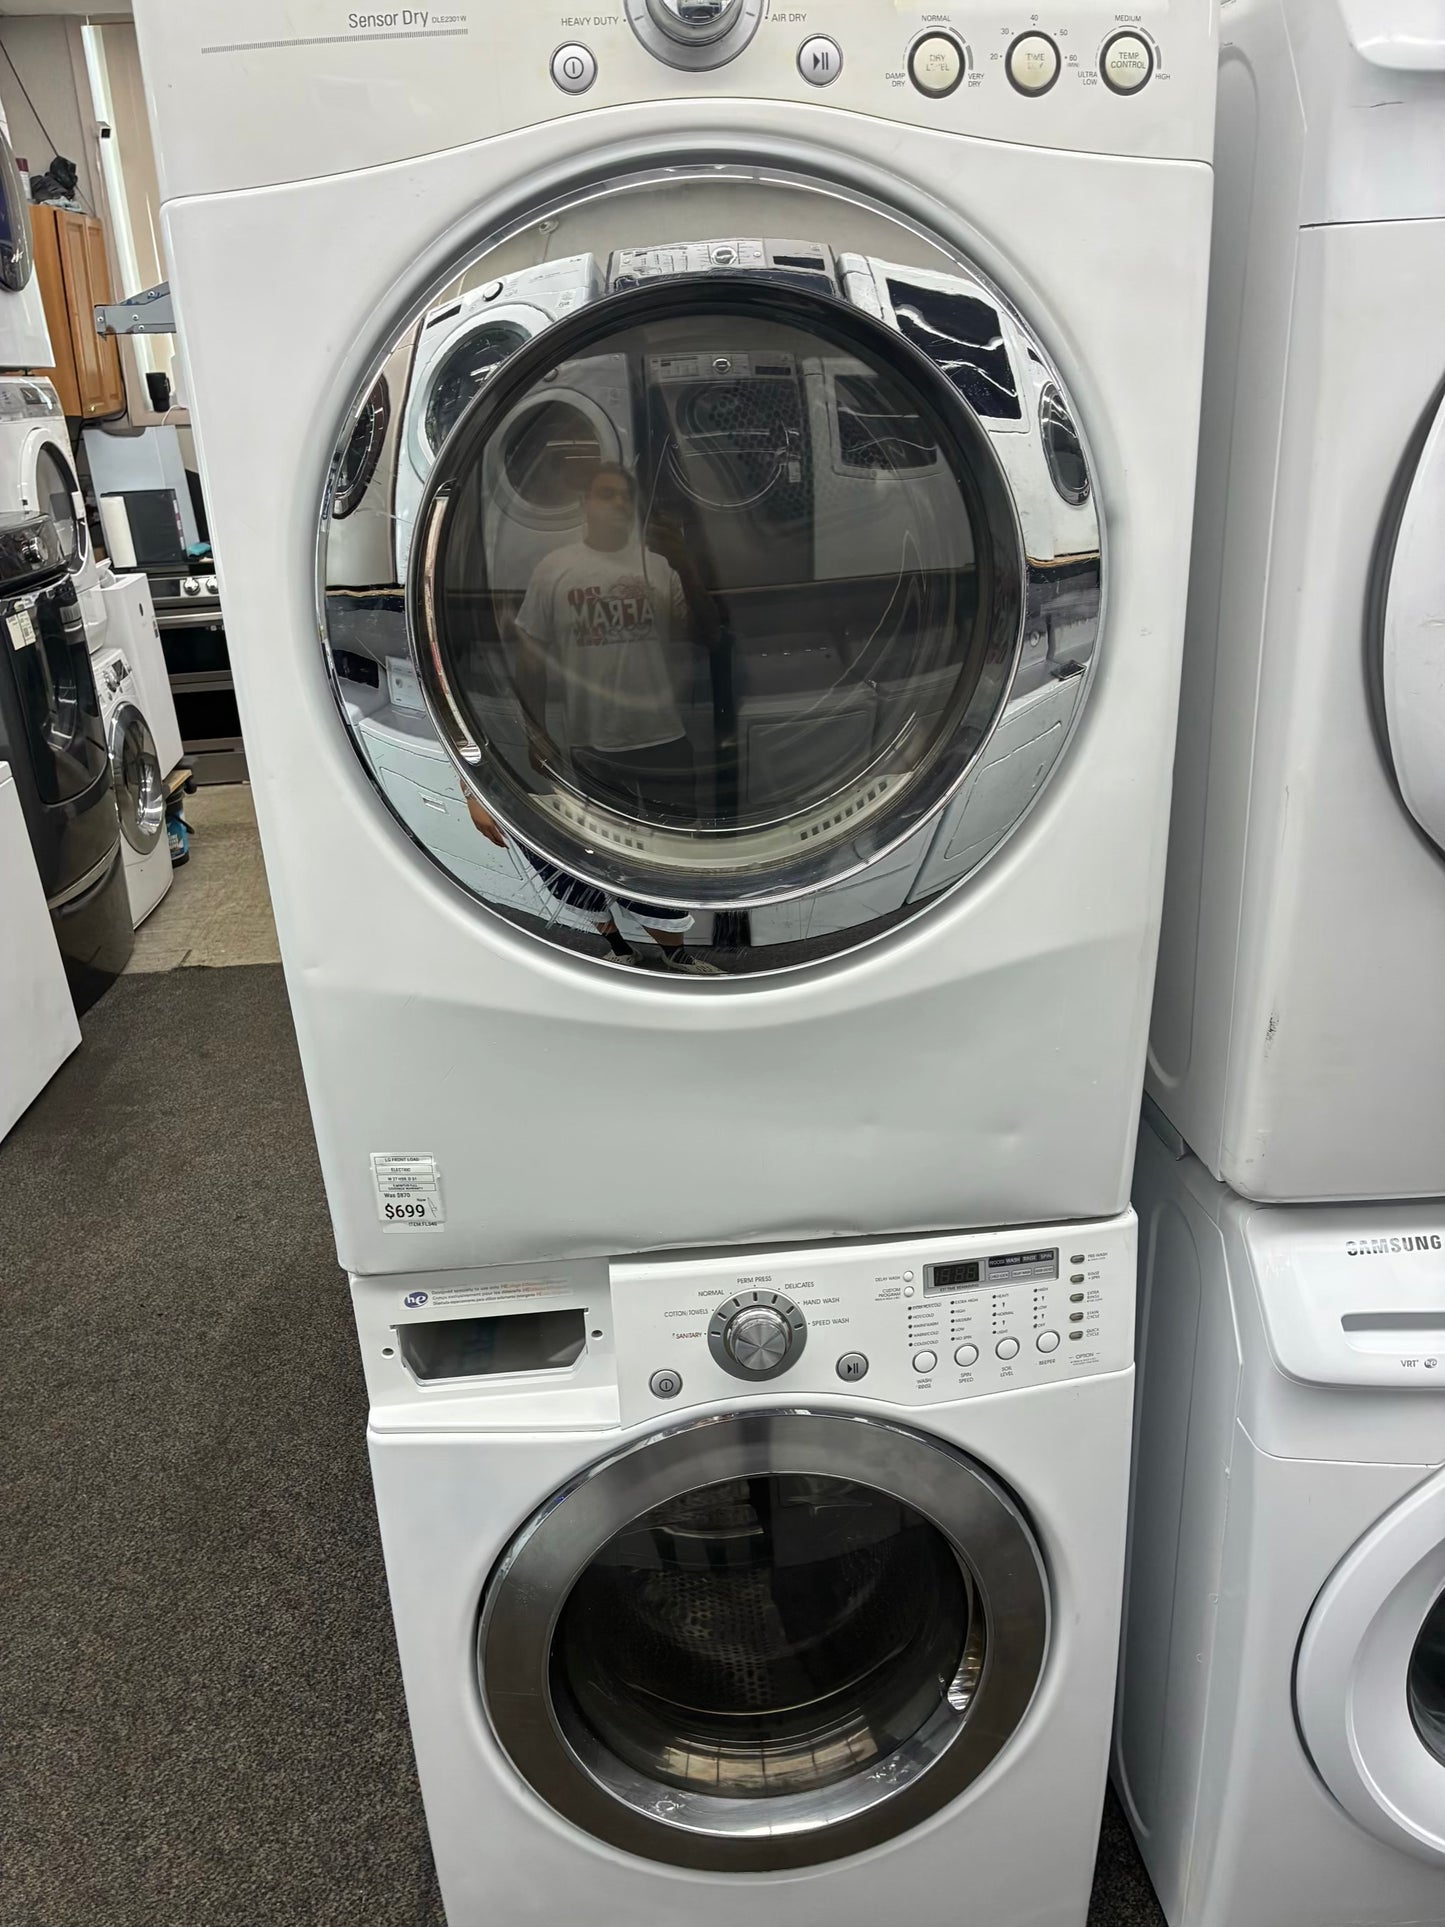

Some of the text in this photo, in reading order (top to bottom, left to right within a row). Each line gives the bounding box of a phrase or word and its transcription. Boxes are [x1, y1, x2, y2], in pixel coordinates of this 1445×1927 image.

[348, 10, 467, 28] Sensor Dry DLE2301W
[561, 16, 619, 26] HEAVY DUTY
[771, 13, 806, 22] AIR DRY
[1059, 28, 1068, 36] 50
[929, 54, 946, 62] DRY
[926, 63, 950, 71] LEL
[1110, 60, 1147, 69] CONTROL
[385, 1203, 425, 1220] $699
[1346, 1234, 1442, 1256] SAMSUNG
[784, 1281, 815, 1289] DELICATES
[406, 1294, 427, 1307] he
